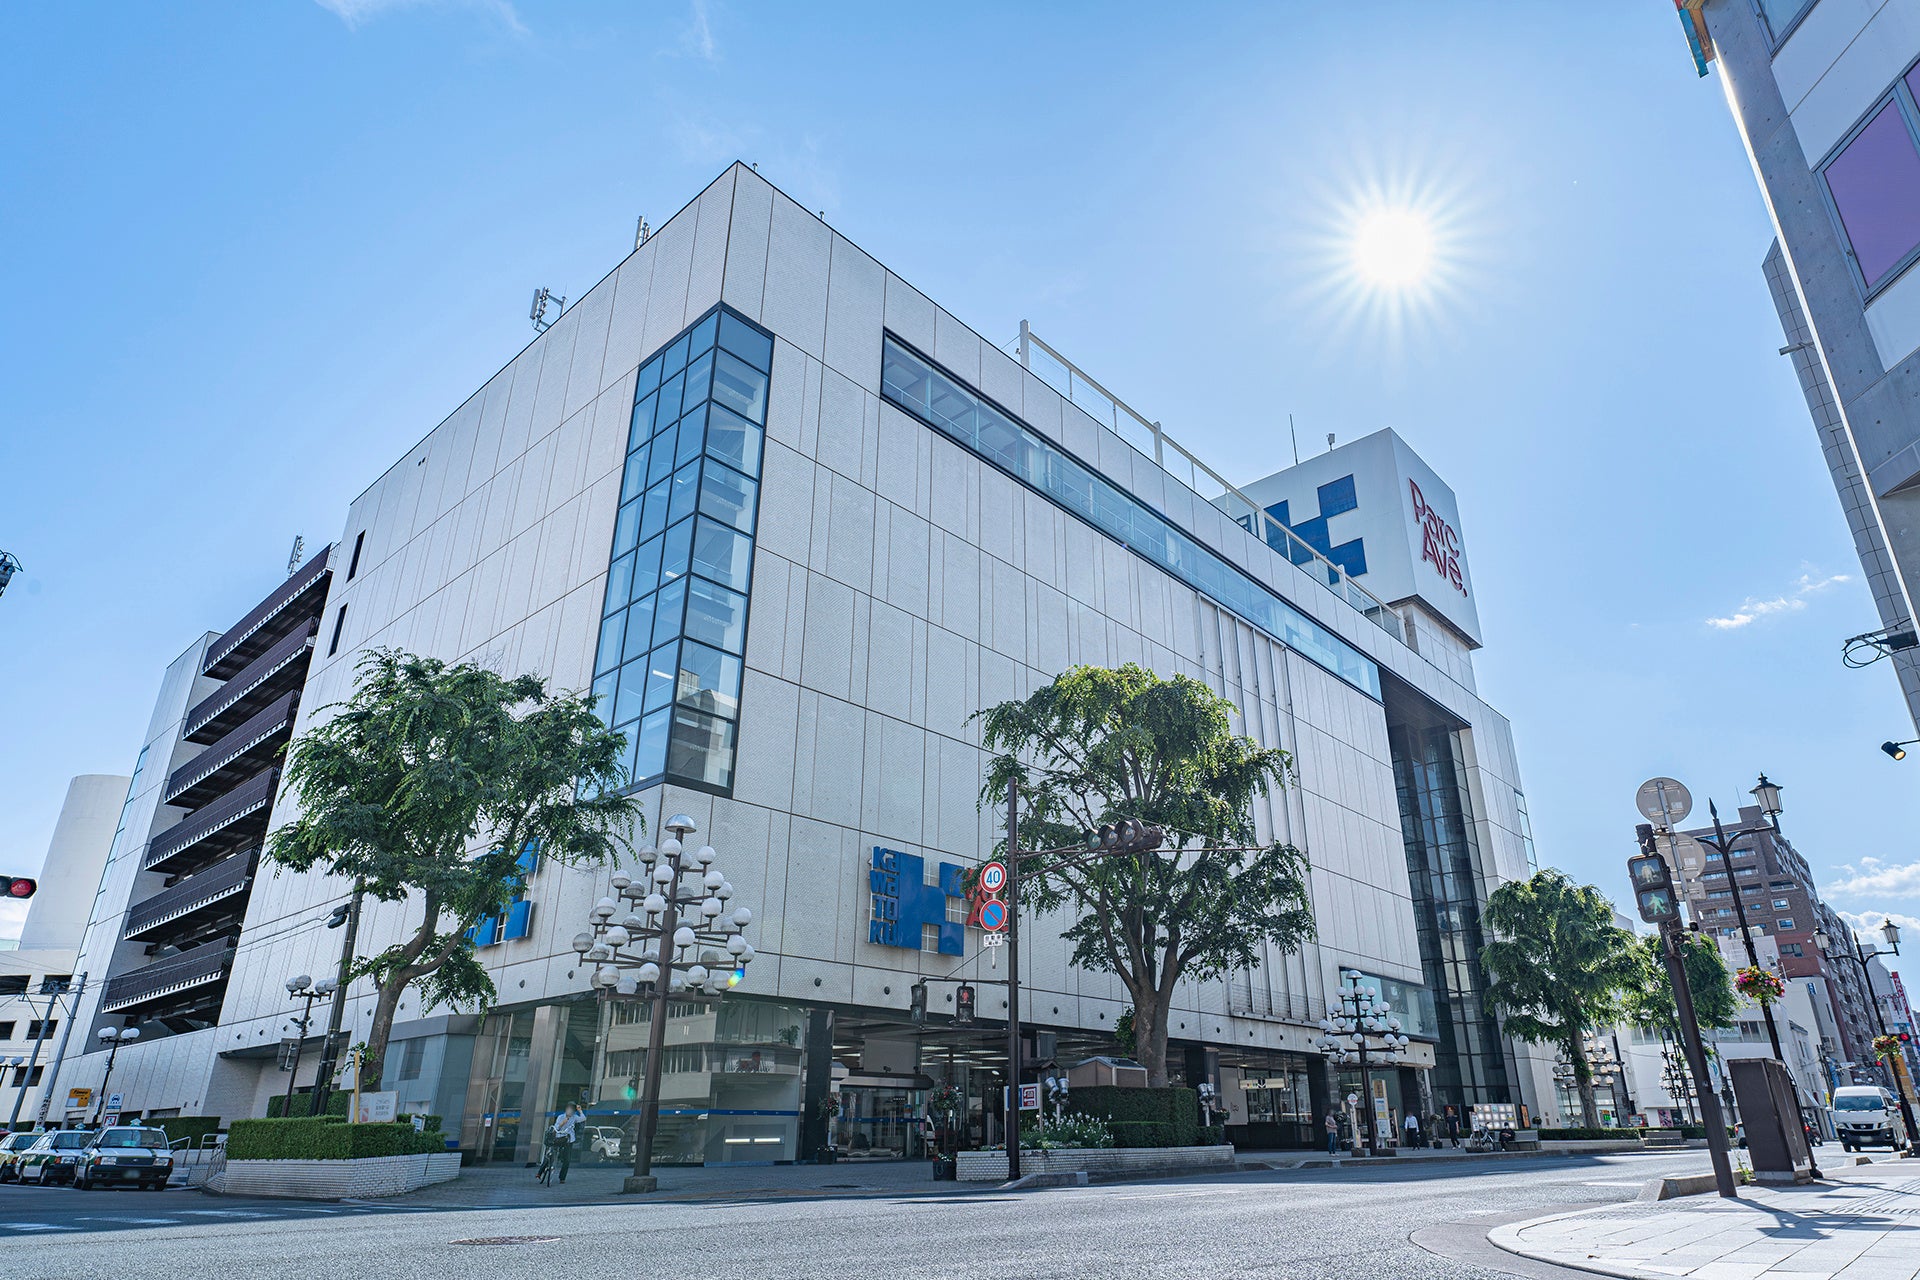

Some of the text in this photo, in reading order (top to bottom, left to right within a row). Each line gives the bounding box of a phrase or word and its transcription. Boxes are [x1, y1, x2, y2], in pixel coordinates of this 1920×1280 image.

[1408, 477, 1459, 558] Parc
[1422, 521, 1468, 598] Ave.
[986, 870, 1001, 885] 40
